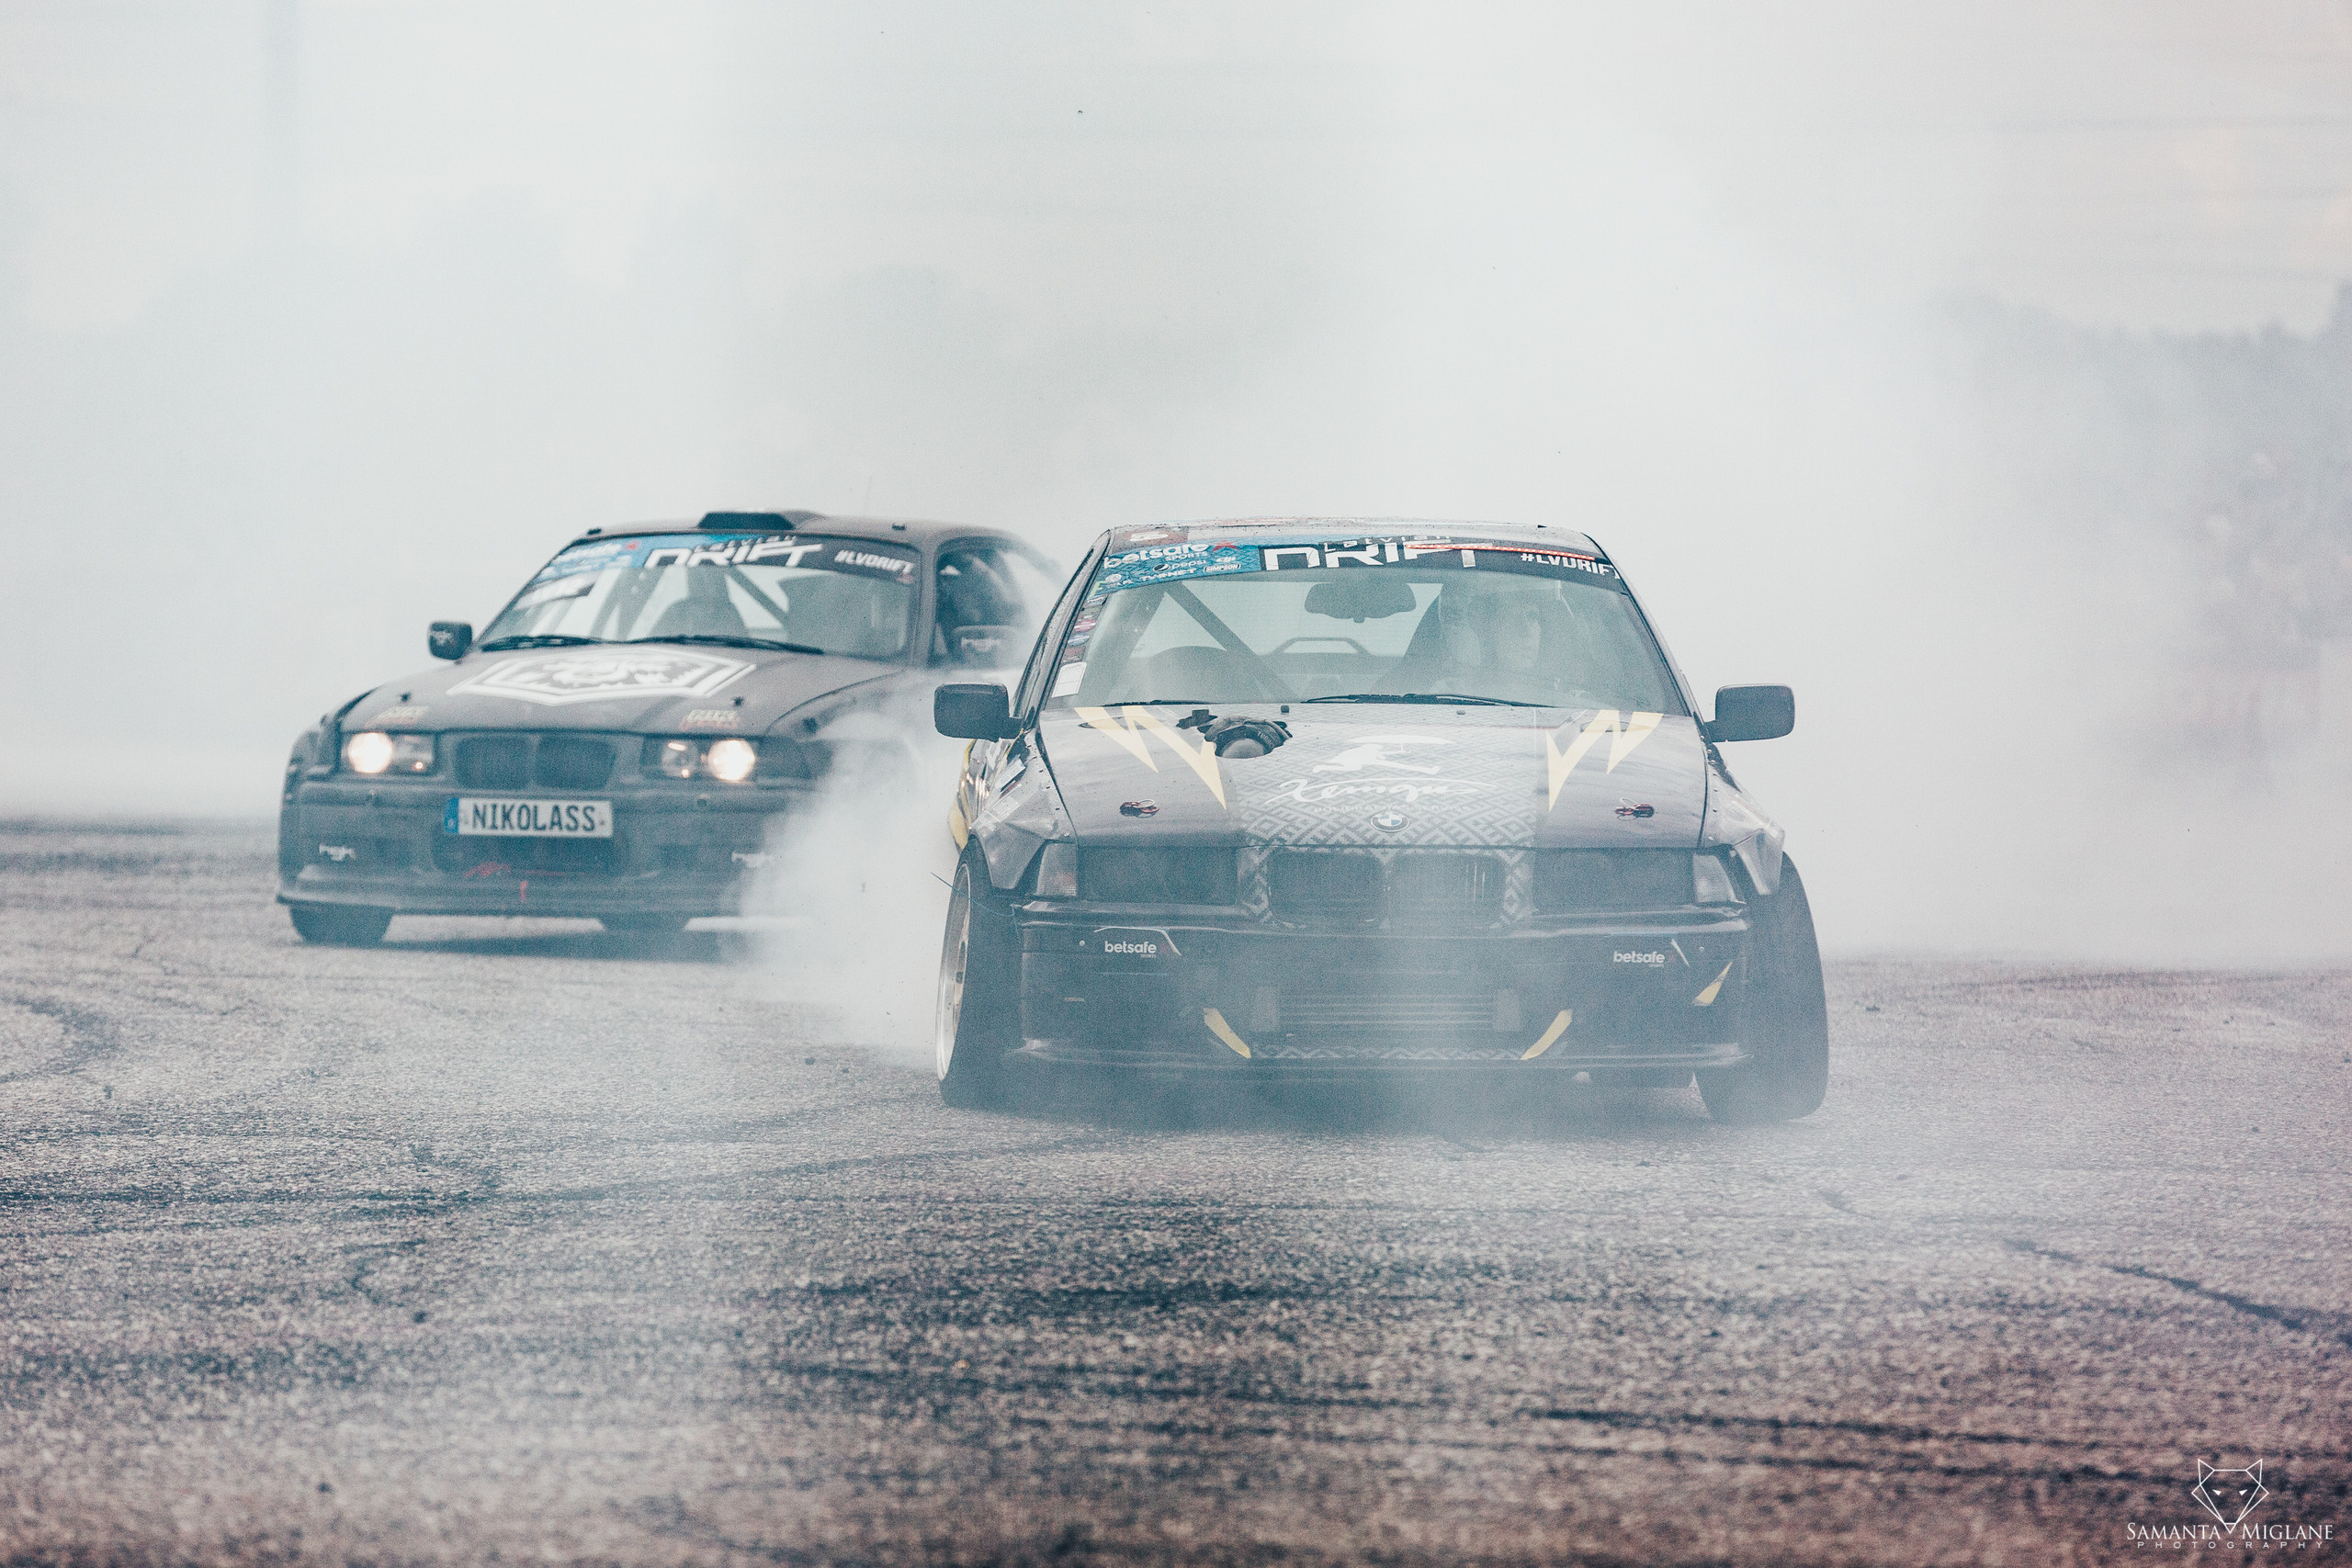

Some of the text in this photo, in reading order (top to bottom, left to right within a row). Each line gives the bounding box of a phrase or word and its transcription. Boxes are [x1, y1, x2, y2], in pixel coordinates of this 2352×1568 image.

[645, 544, 824, 570] DRIFT
[1102, 542, 1210, 570] betsafe
[1165, 551, 1208, 562] SPORTS
[1263, 538, 1494, 571] DRIFT
[1171, 559, 1207, 570] pepsi
[1205, 564, 1240, 573] SIMPSON
[472, 802, 596, 832] NIKOLASS
[1104, 941, 1157, 953] betsafe
[1612, 950, 1666, 964] betsafe
